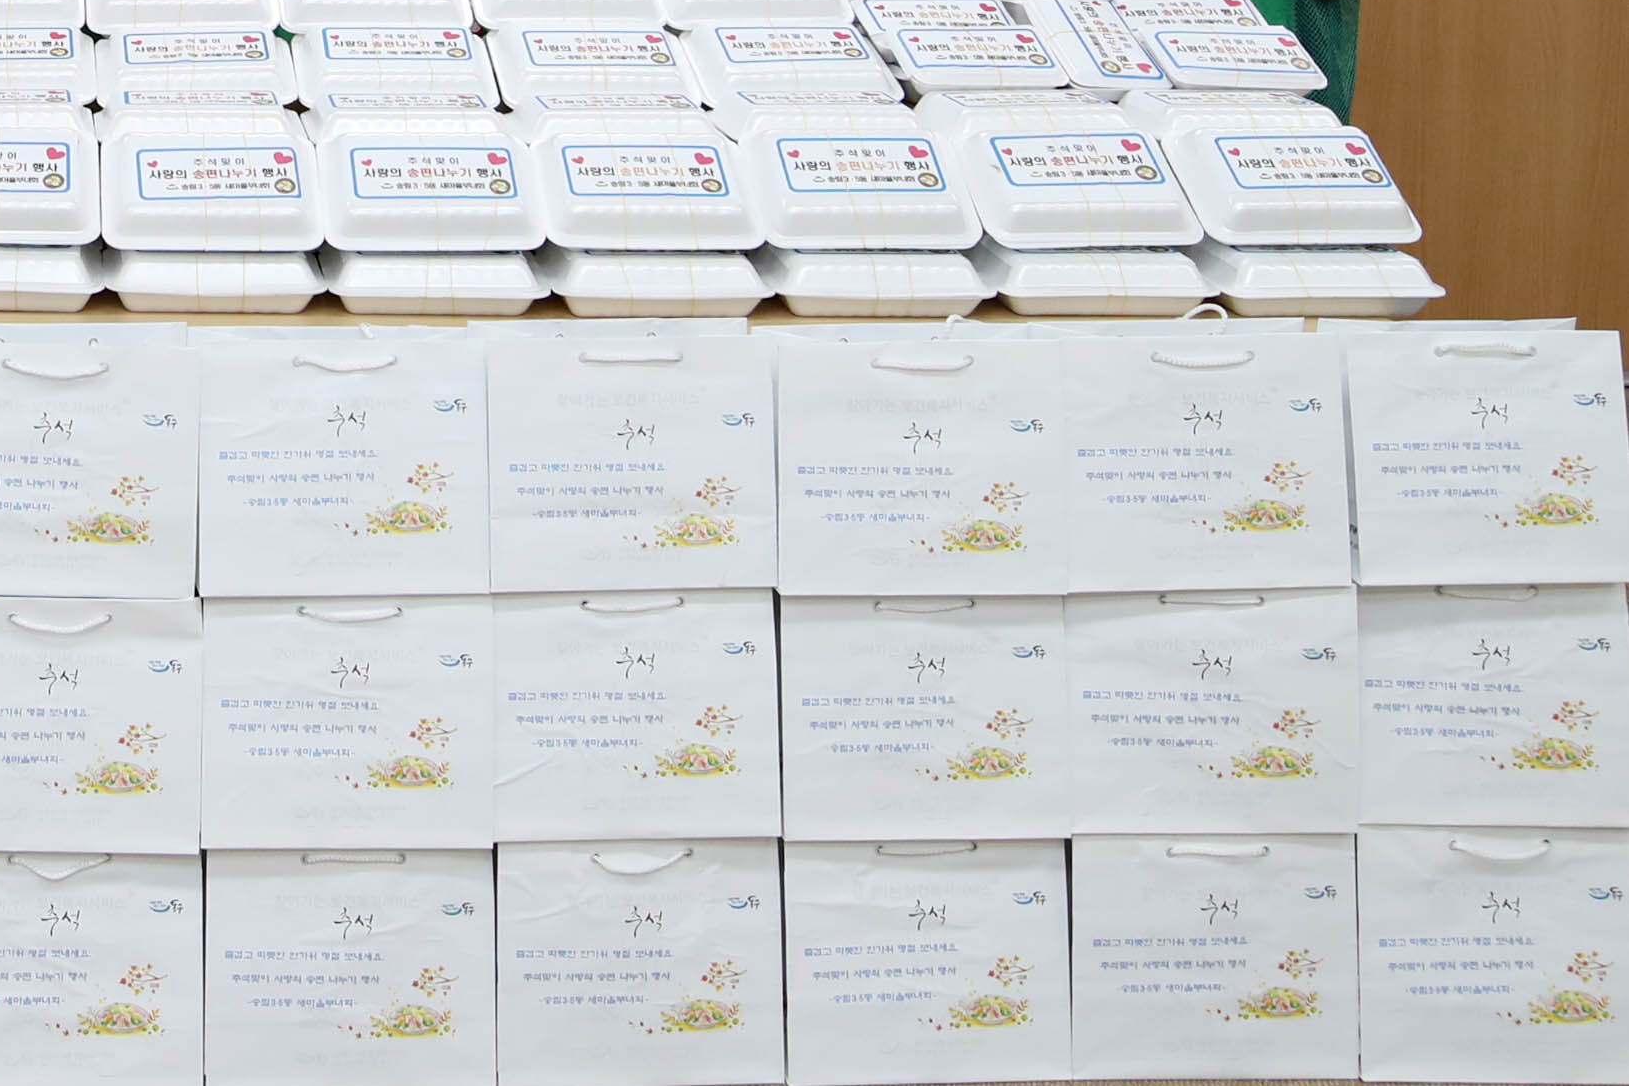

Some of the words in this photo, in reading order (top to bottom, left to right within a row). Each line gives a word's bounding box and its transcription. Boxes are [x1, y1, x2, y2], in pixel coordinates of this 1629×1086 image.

[791, 160, 832, 170] 사랑의
[902, 160, 929, 170] 행사
[1007, 156, 1048, 166] 사랑의
[1115, 154, 1145, 164] 행사
[1234, 157, 1277, 167] 사랑의
[1342, 158, 1371, 167] 행사
[32, 162, 57, 172] 행사
[362, 167, 402, 177] 사랑의
[476, 168, 502, 177] 행사
[575, 165, 616, 175] 사랑의
[686, 167, 713, 176] 행사
[148, 169, 188, 179] 사랑의
[261, 167, 287, 177] 행사
